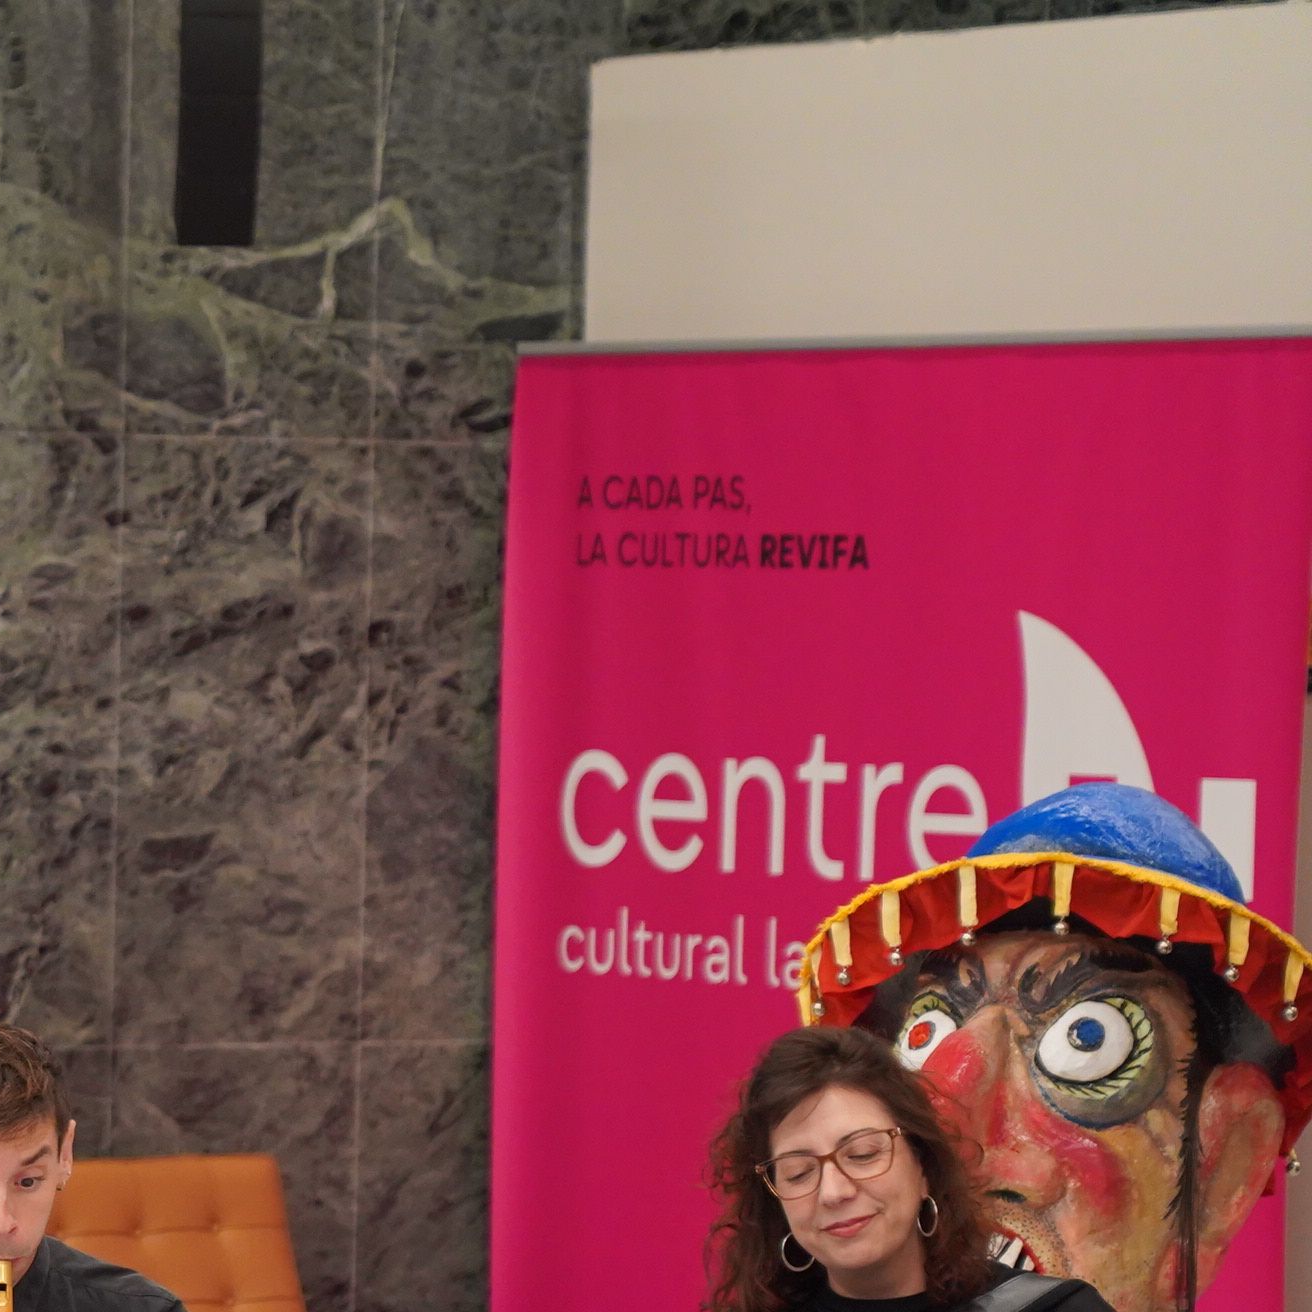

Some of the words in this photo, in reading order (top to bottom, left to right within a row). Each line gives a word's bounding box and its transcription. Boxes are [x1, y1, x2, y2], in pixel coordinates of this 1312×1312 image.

[576, 475, 593, 509] A
[602, 475, 683, 511] CADA
[692, 475, 752, 516] PAS,
[576, 532, 607, 569] LA
[617, 531, 750, 569] CULTURA
[759, 533, 870, 570] REVIFA
[560, 733, 989, 883] centre
[558, 905, 748, 985] cultural
[766, 915, 805, 990] la
